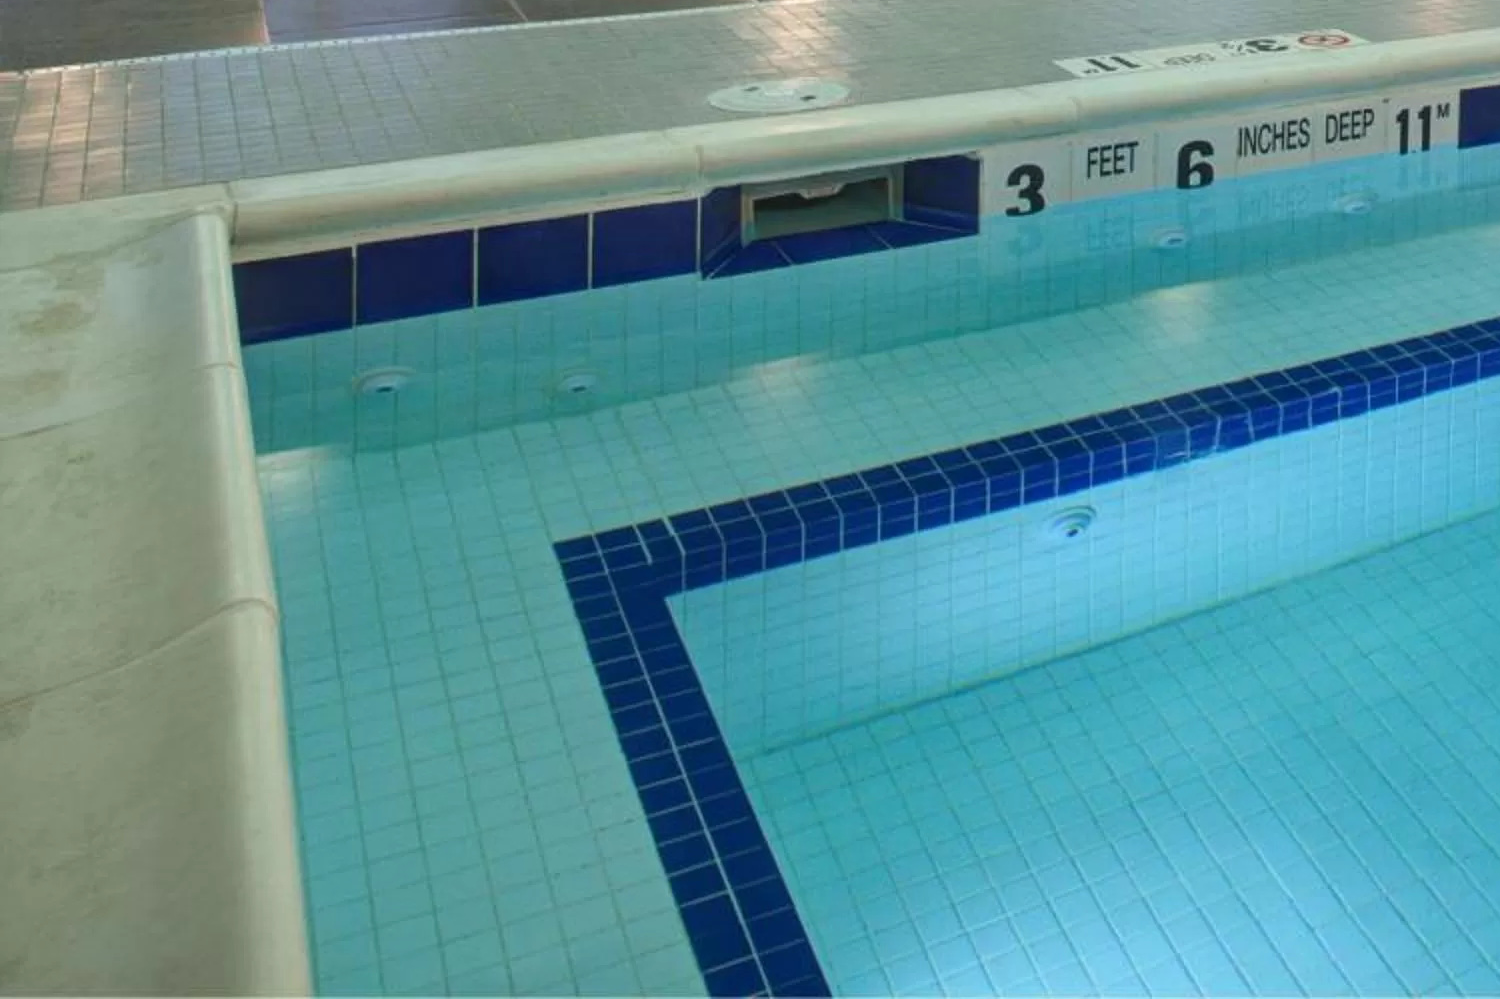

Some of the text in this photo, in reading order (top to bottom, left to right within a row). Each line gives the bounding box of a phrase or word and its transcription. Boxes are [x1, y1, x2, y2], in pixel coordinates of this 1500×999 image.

[1006, 164, 1045, 217] 3
[1087, 141, 1139, 179] FEET
[1176, 140, 1214, 189] 6
[1237, 117, 1310, 157] INCHES
[1326, 108, 1374, 144] DEEP
